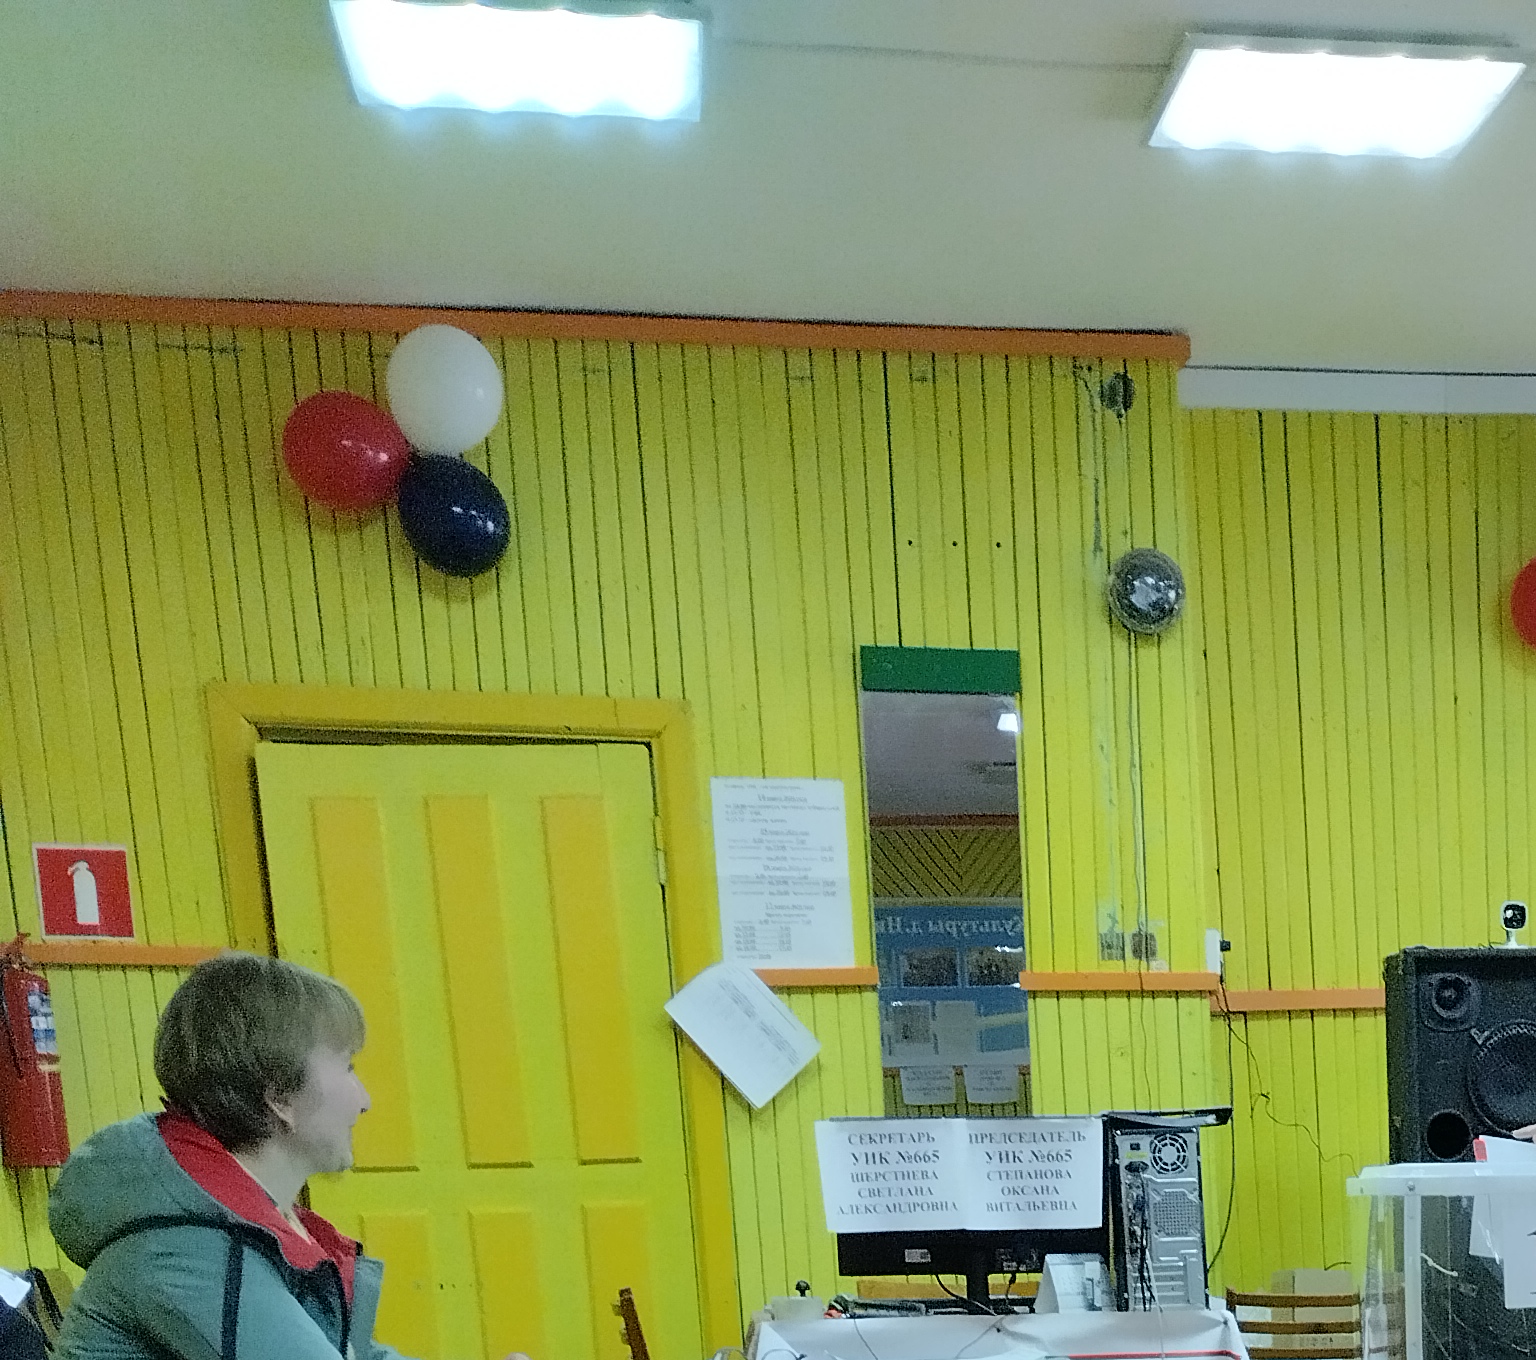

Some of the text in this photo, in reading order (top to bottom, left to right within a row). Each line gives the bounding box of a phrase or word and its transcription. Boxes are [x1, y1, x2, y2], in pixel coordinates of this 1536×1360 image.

[847, 1131, 935, 1145] СЕКРЕТАРЬ
[968, 1131, 1086, 1145] ПРЕДСЕДАТЕЛЬ
[850, 1150, 940, 1166] УИК №665
[984, 1149, 1073, 1165] УИК №665
[850, 1170, 939, 1183] ШЕРСТНЕВА
[986, 1169, 1072, 1181] СТЕПАНОВА
[857, 1185, 934, 1199] СВЕТЛАНА
[1000, 1184, 1060, 1197] ОКСАНА
[837, 1200, 959, 1215] АЛЕКСАНДРОВНА
[986, 1200, 1078, 1213] ВИТАЛЬЕВНА
